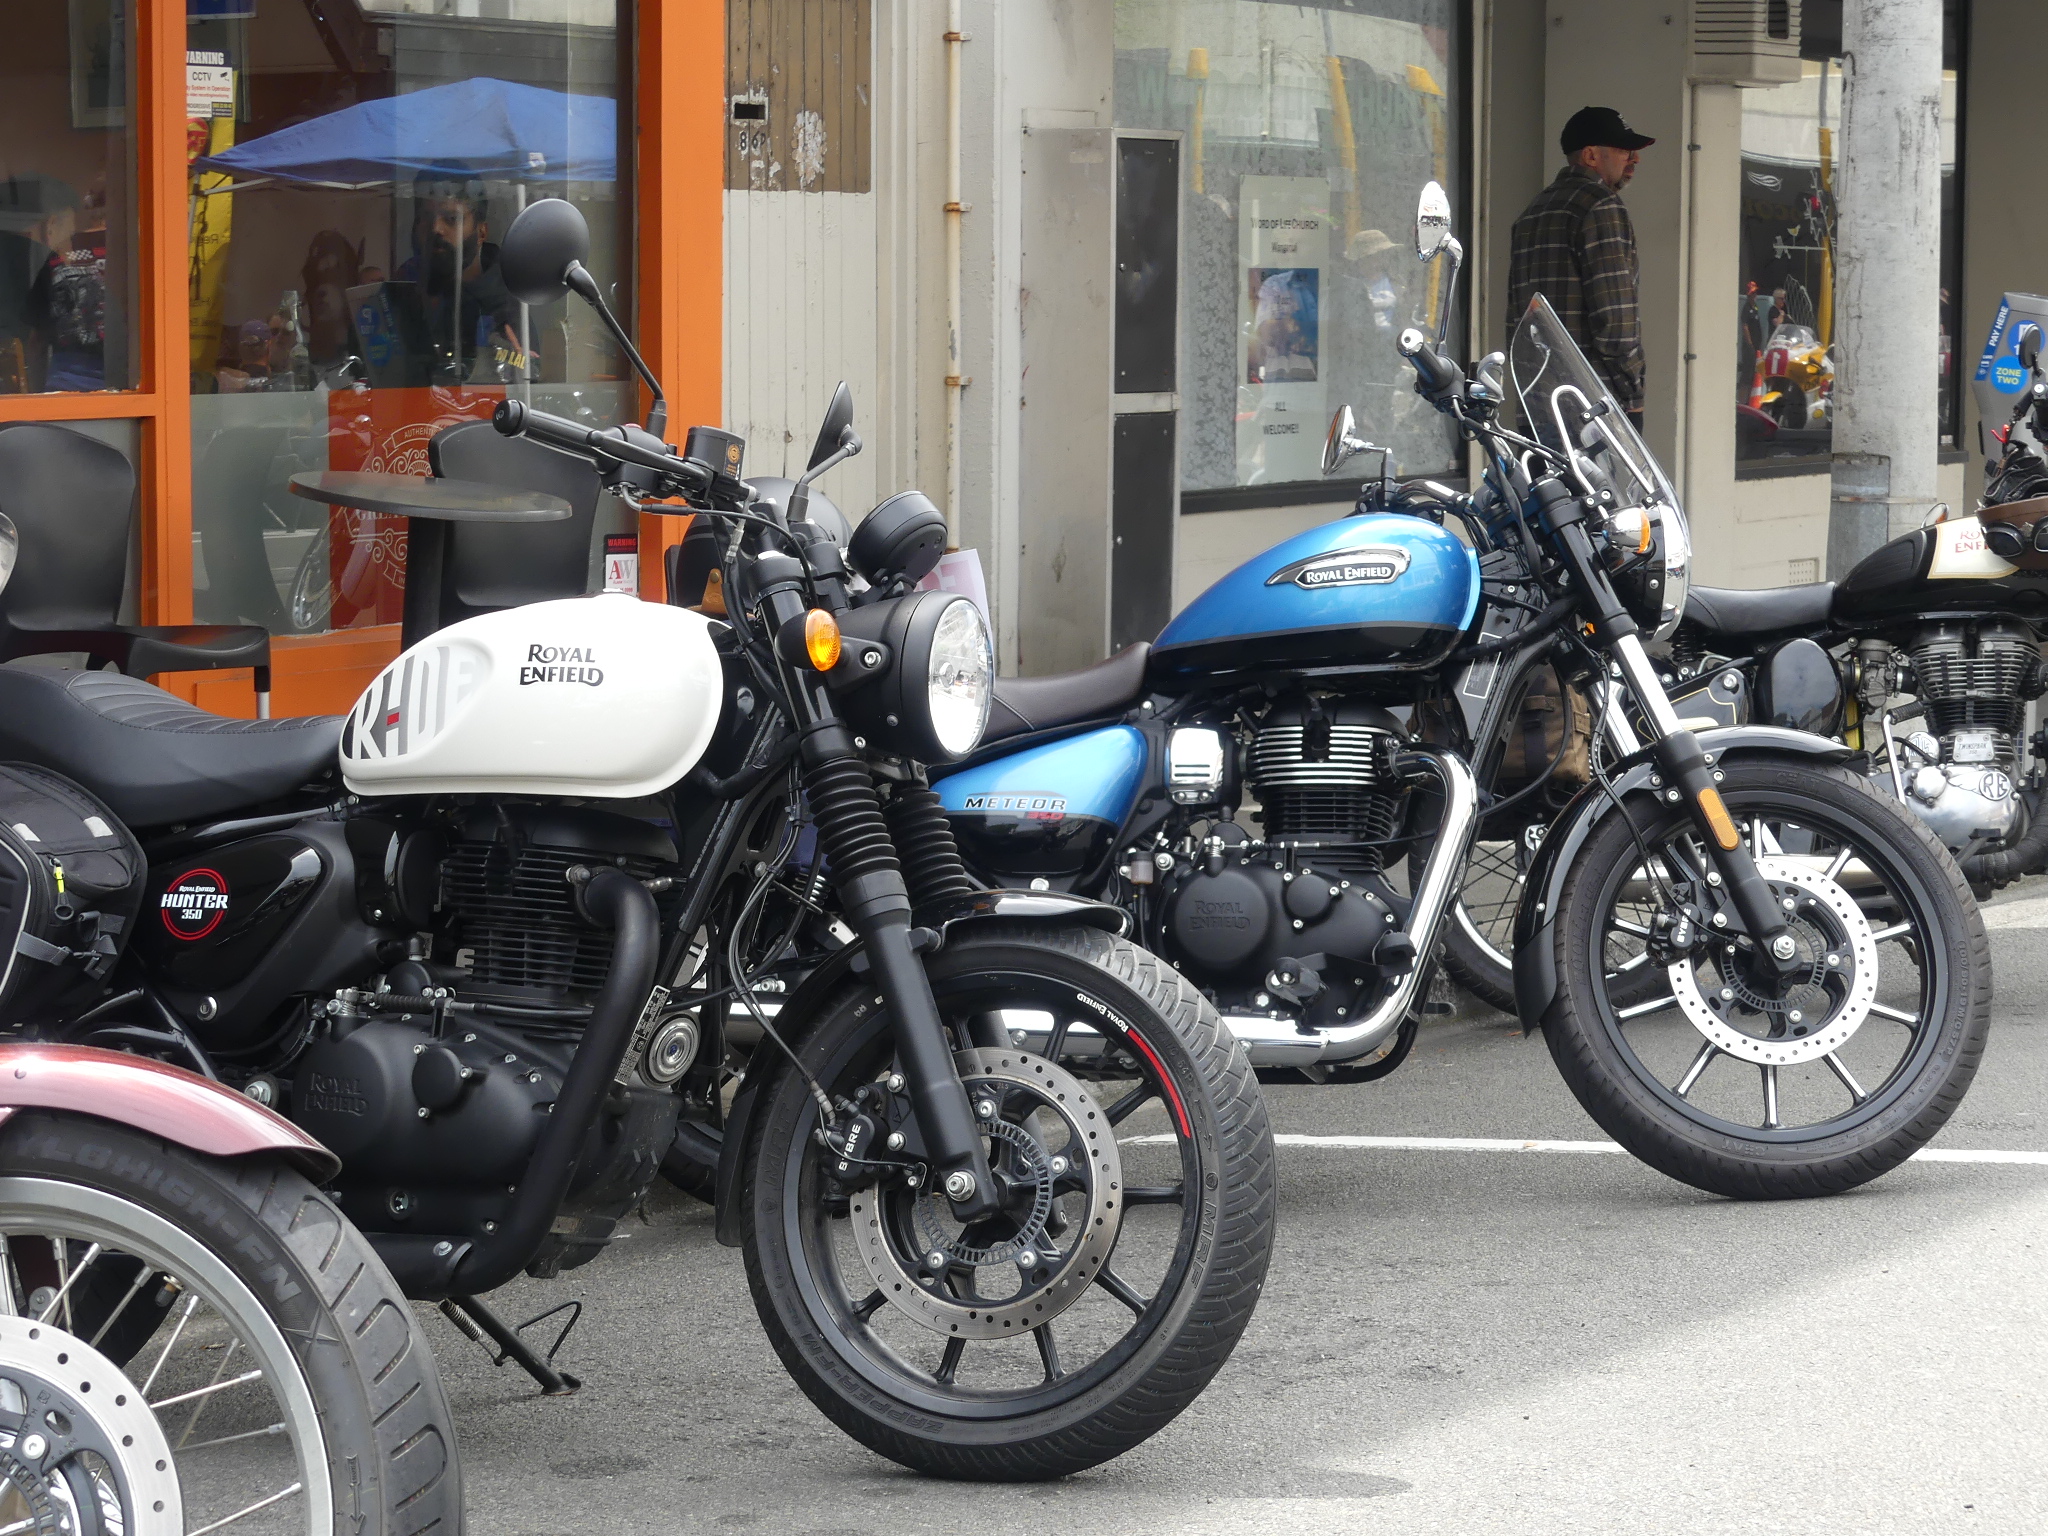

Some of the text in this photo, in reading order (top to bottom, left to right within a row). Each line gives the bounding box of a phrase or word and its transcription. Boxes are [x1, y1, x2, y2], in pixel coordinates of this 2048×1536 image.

[192, 72, 211, 80] CCTV
[1989, 306, 2008, 346] PAY HERE
[1996, 367, 2021, 377] ZONE
[1997, 375, 2019, 385] TWO
[404, 427, 438, 439] AUTHENTI
[608, 538, 636, 546] WARNING
[1306, 566, 1392, 583] ROYAL ENFIELD
[528, 643, 595, 663] ROYAL
[519, 666, 604, 687] ENFIELD
[1984, 773, 2007, 798] RE
[965, 797, 1066, 811] METEOR
[1026, 811, 1064, 820] 350
[161, 893, 228, 909] HUNTER
[1195, 900, 1243, 915] ROYAL
[181, 908, 203, 920] 350
[1189, 916, 1250, 931] ENFIELD
[1077, 993, 1129, 1033] ROYAL ENFIELD
[311, 1072, 362, 1094] ROYAL
[1186, 1201, 1217, 1290] MRF
[799, 1323, 944, 1445] ZAPPER-FM
